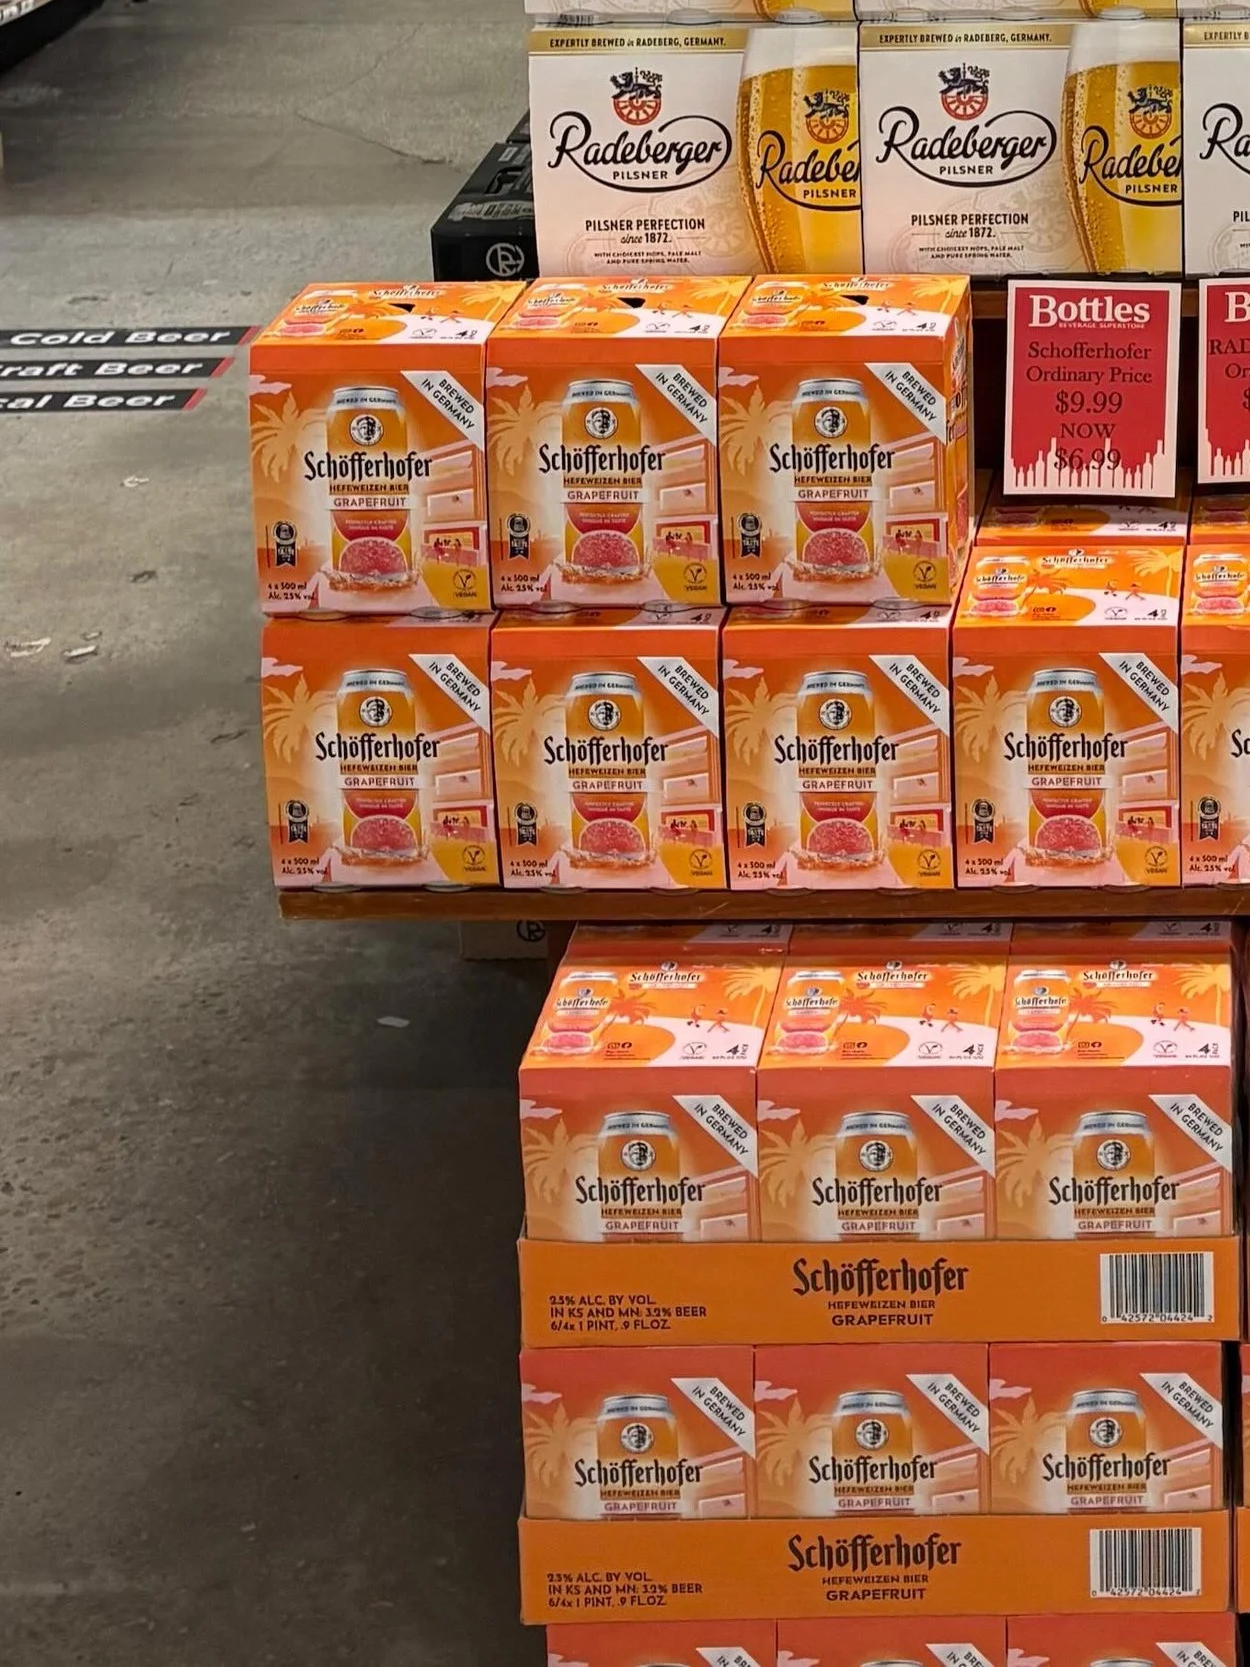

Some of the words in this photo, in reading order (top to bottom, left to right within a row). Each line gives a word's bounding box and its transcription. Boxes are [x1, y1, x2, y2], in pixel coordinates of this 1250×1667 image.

[548, 111, 722, 175] Radeberger
[876, 106, 1047, 169] Radeberger
[939, 165, 993, 175] PILSNER
[1029, 294, 1150, 328] Bottles
[10, 331, 115, 345] Cold
[125, 331, 231, 344] Beer
[1028, 341, 1152, 359] Schofferhofer
[95, 362, 204, 376] Beer
[1026, 365, 1103, 385] Ordinary
[1109, 367, 1153, 383] Price
[63, 394, 176, 407] Beer
[1055, 391, 1123, 414] $9.99
[1061, 423, 1116, 439] NOW
[304, 450, 433, 481] Schöfferhofer
[539, 444, 665, 474] Schöfferhofer
[770, 442, 895, 473] Schöfferhofer
[1053, 447, 1121, 471] $6.99
[315, 732, 440, 762] Schöfferhofer
[544, 735, 668, 765] Schöfferhofer
[774, 735, 899, 764] Schöfferhofer
[1004, 732, 1128, 761] Schöfferhofer
[575, 1176, 706, 1206] Schöfferhofer
[1049, 1176, 1180, 1206] Schöfferhofer
[793, 1257, 969, 1296] Schöfferhofer
[828, 1300, 905, 1310] HEFEWEIZEN
[910, 1300, 936, 1310] BIER
[832, 1314, 934, 1327] GRAPEFRUIT
[574, 1459, 702, 1487] Schöfferhofer
